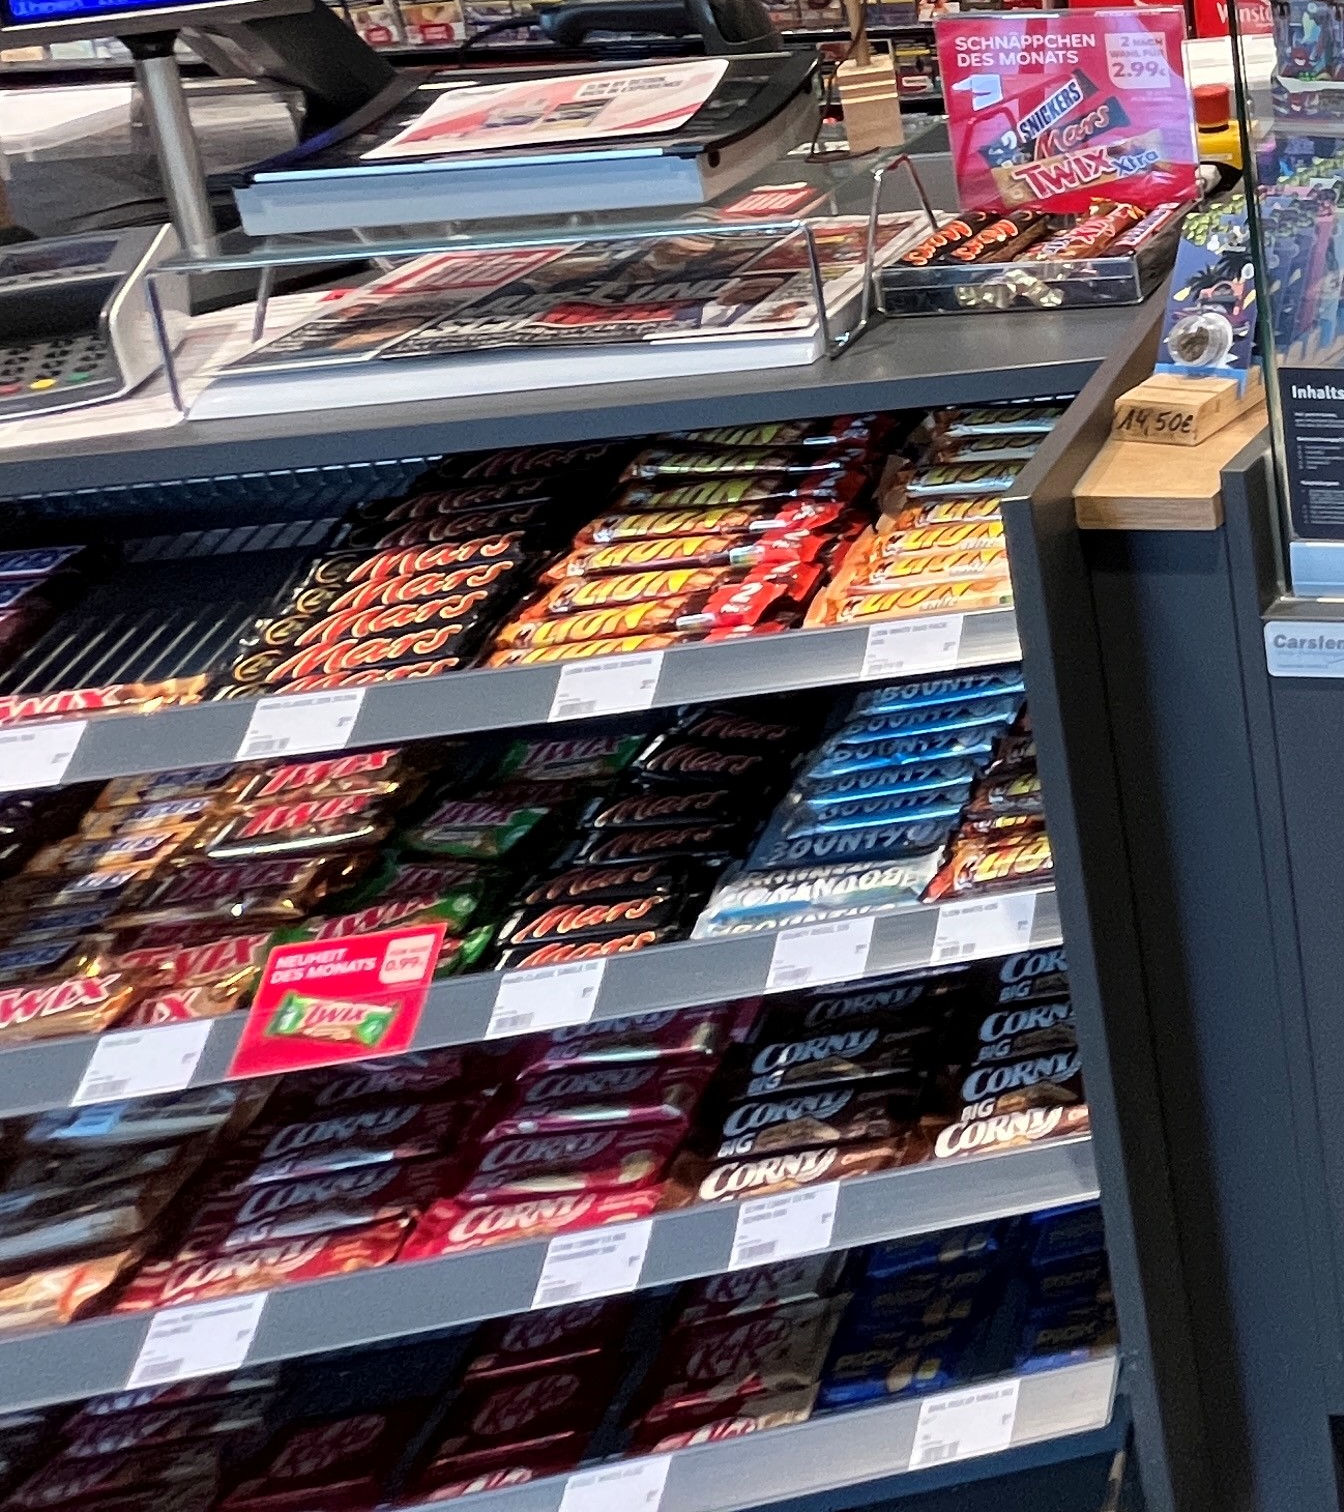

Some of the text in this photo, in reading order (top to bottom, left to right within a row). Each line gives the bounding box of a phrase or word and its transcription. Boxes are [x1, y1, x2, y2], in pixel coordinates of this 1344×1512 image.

[955, 31, 1096, 52] SCHNÄPPCHEN
[957, 50, 1079, 68] DES MONATS
[1120, 36, 1130, 48] 2
[1019, 80, 1082, 139] SNICKERS
[1013, 149, 1113, 200] TWIX
[1111, 150, 1159, 177] Xtra
[345, 531, 526, 583] Mars
[588, 536, 707, 570] LION
[327, 561, 515, 612] Mars
[572, 569, 696, 607] LION
[852, 581, 972, 617] LION
[294, 591, 488, 646] Mars
[530, 601, 658, 645] LION
[265, 624, 463, 683] Mars
[881, 674, 996, 701] BOUNTY
[511, 895, 665, 944] Mars
[270, 957, 377, 985] DES MONATS
[275, 947, 349, 969] NEUHEIT
[751, 1028, 880, 1075] CORNY
[962, 1050, 1083, 1103] CORNY
[722, 1088, 855, 1137] CORNY
[935, 1106, 1065, 1160] CORNY
[961, 1098, 997, 1123] BIG
[717, 1132, 753, 1159] BIG
[700, 1147, 839, 1202] CORNY
[447, 1193, 597, 1243] CORNY
